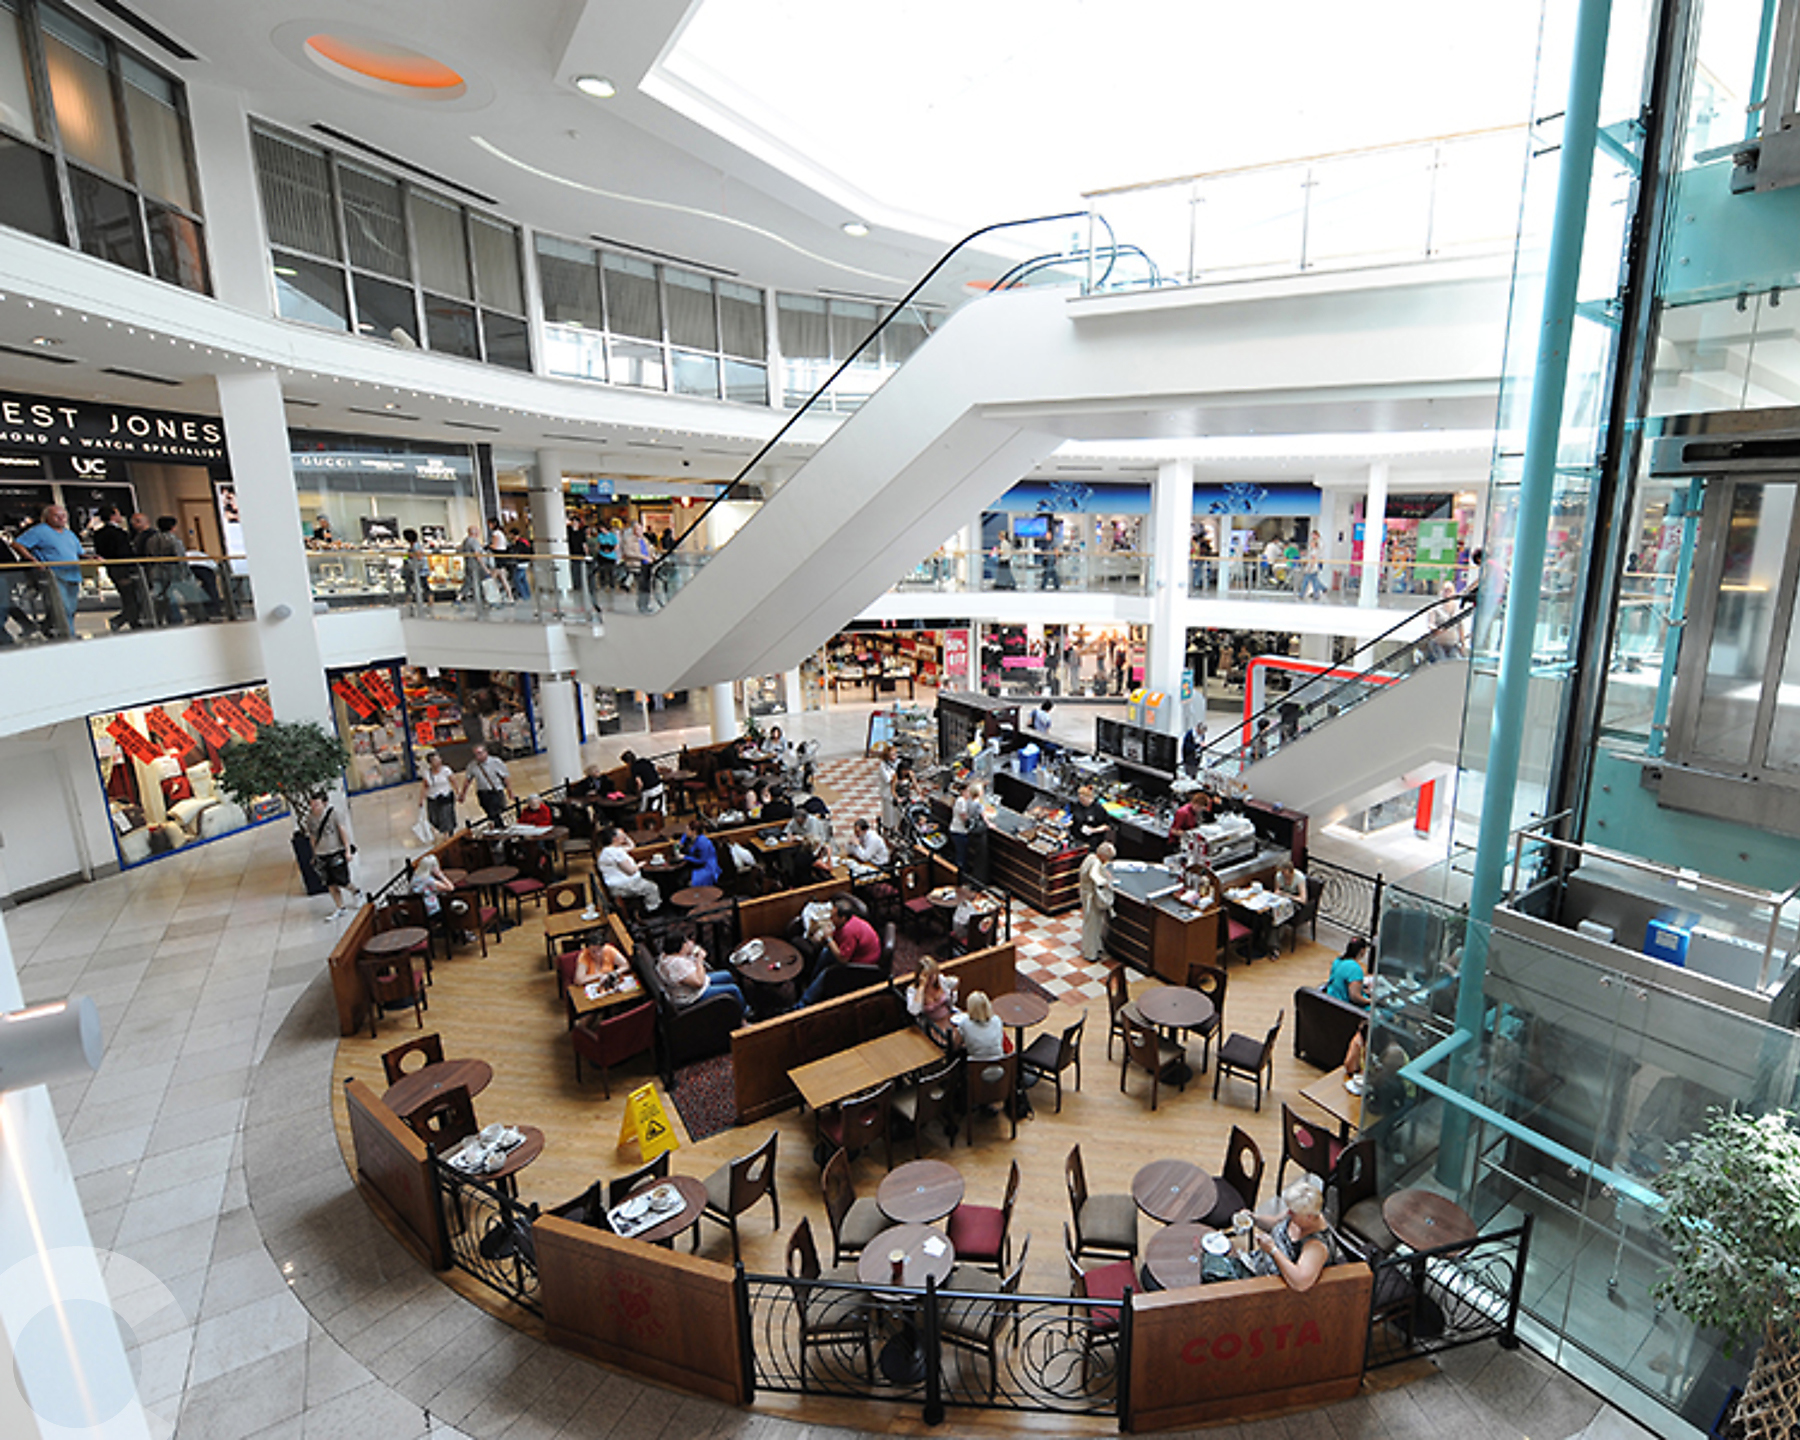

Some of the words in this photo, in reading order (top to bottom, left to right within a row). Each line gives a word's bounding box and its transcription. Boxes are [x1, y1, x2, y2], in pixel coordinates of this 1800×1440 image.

[2, 401, 78, 429] EST
[109, 413, 222, 443] JONES
[80, 437, 135, 451] WATCH
[142, 442, 222, 458] SPECIALIST
[301, 456, 352, 467] GUCCI
[1180, 1319, 1322, 1366] COSTA
